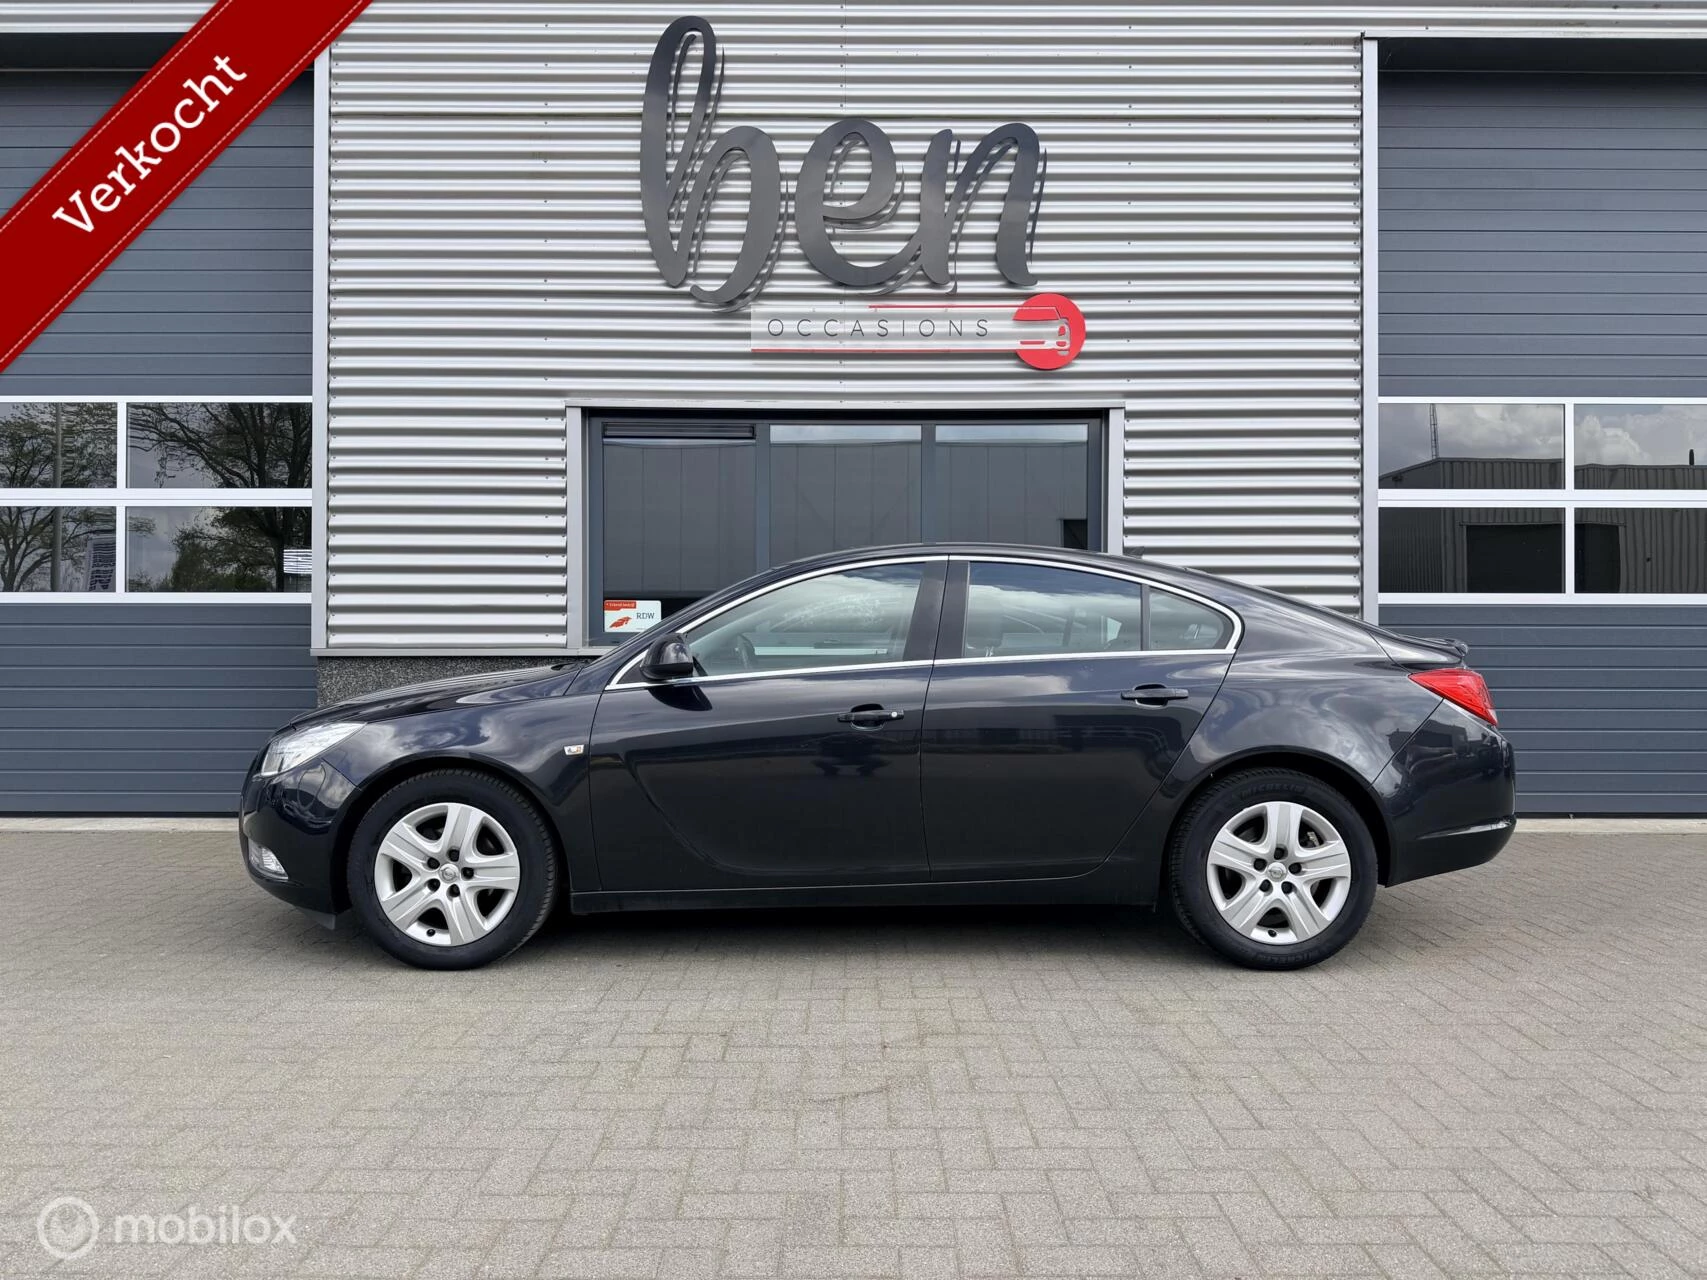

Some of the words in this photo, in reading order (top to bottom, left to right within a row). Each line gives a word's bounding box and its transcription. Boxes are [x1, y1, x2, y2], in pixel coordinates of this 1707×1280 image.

[640, 15, 1041, 304] ben
[767, 318, 989, 337] OCCASIONS
[636, 612, 655, 620] RDW
